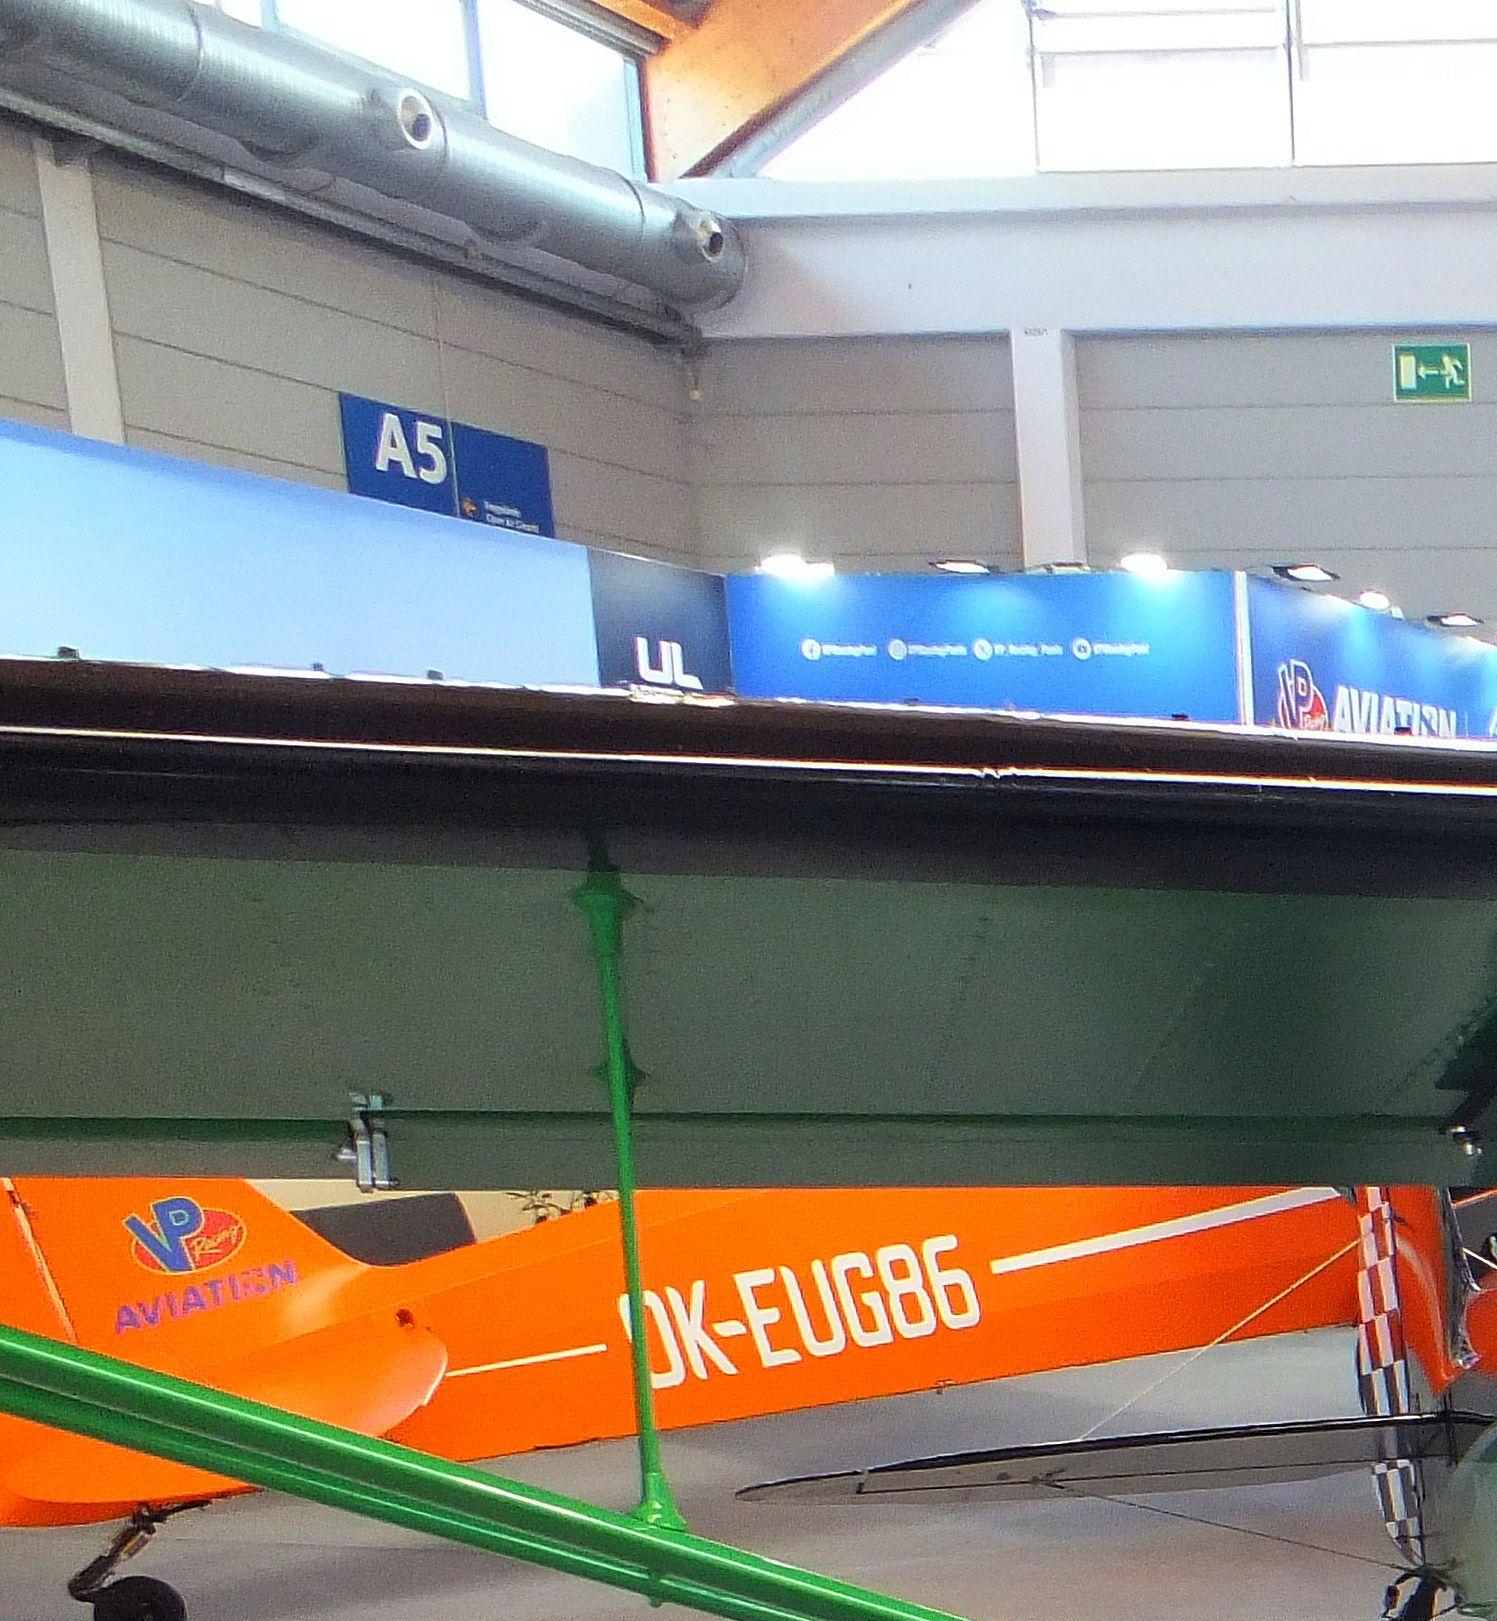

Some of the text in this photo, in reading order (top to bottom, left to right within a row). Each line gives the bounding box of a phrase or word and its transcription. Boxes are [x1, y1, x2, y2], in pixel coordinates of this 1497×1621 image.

[375, 413, 448, 485] A5
[635, 636, 704, 690] UL
[122, 1196, 205, 1274] VP
[618, 1234, 982, 1390] OK-EUG86
